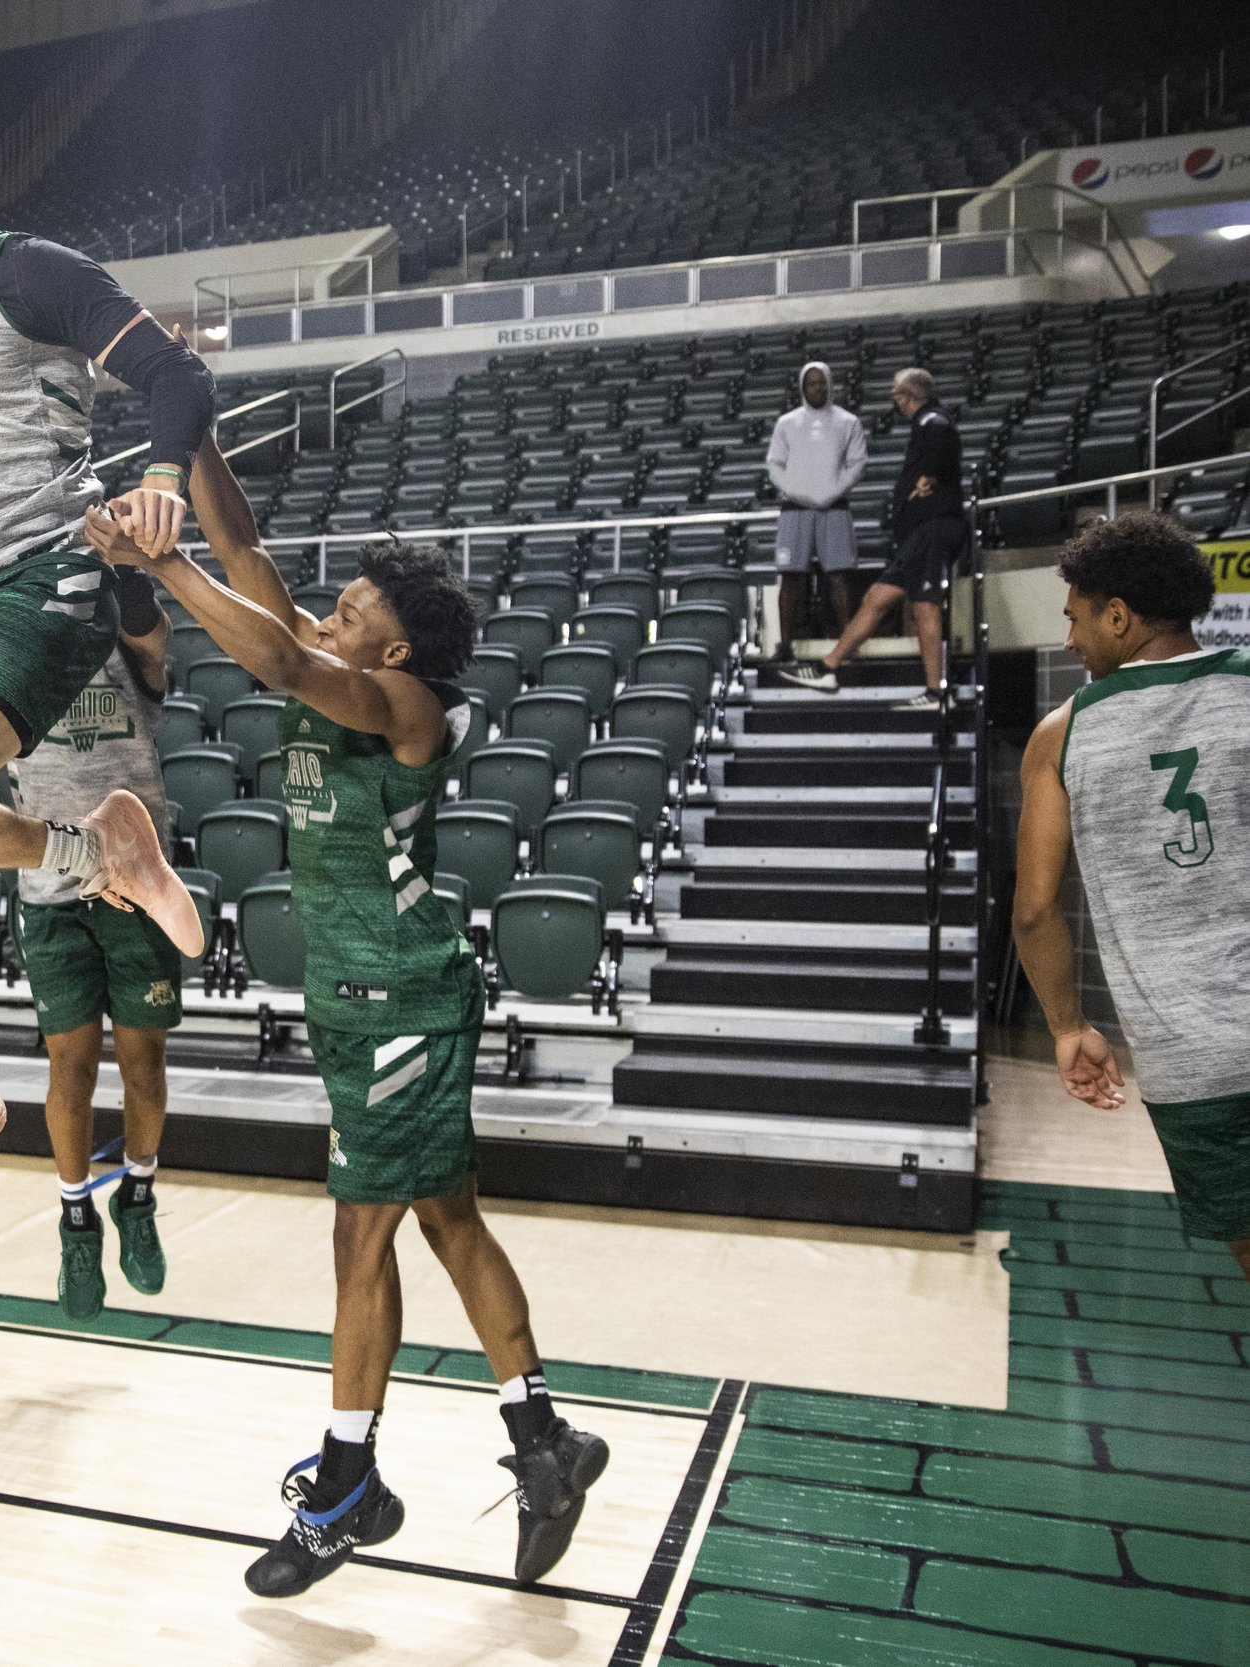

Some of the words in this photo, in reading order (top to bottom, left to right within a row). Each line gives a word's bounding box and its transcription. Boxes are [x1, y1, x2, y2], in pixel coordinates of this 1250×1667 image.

[1115, 157, 1179, 180] pepsi
[1230, 152, 1250, 171] p
[498, 322, 599, 344] RESERVED
[1213, 604, 1243, 621] with
[1196, 629, 1250, 646] hildhoo
[1150, 746, 1215, 868] 3
